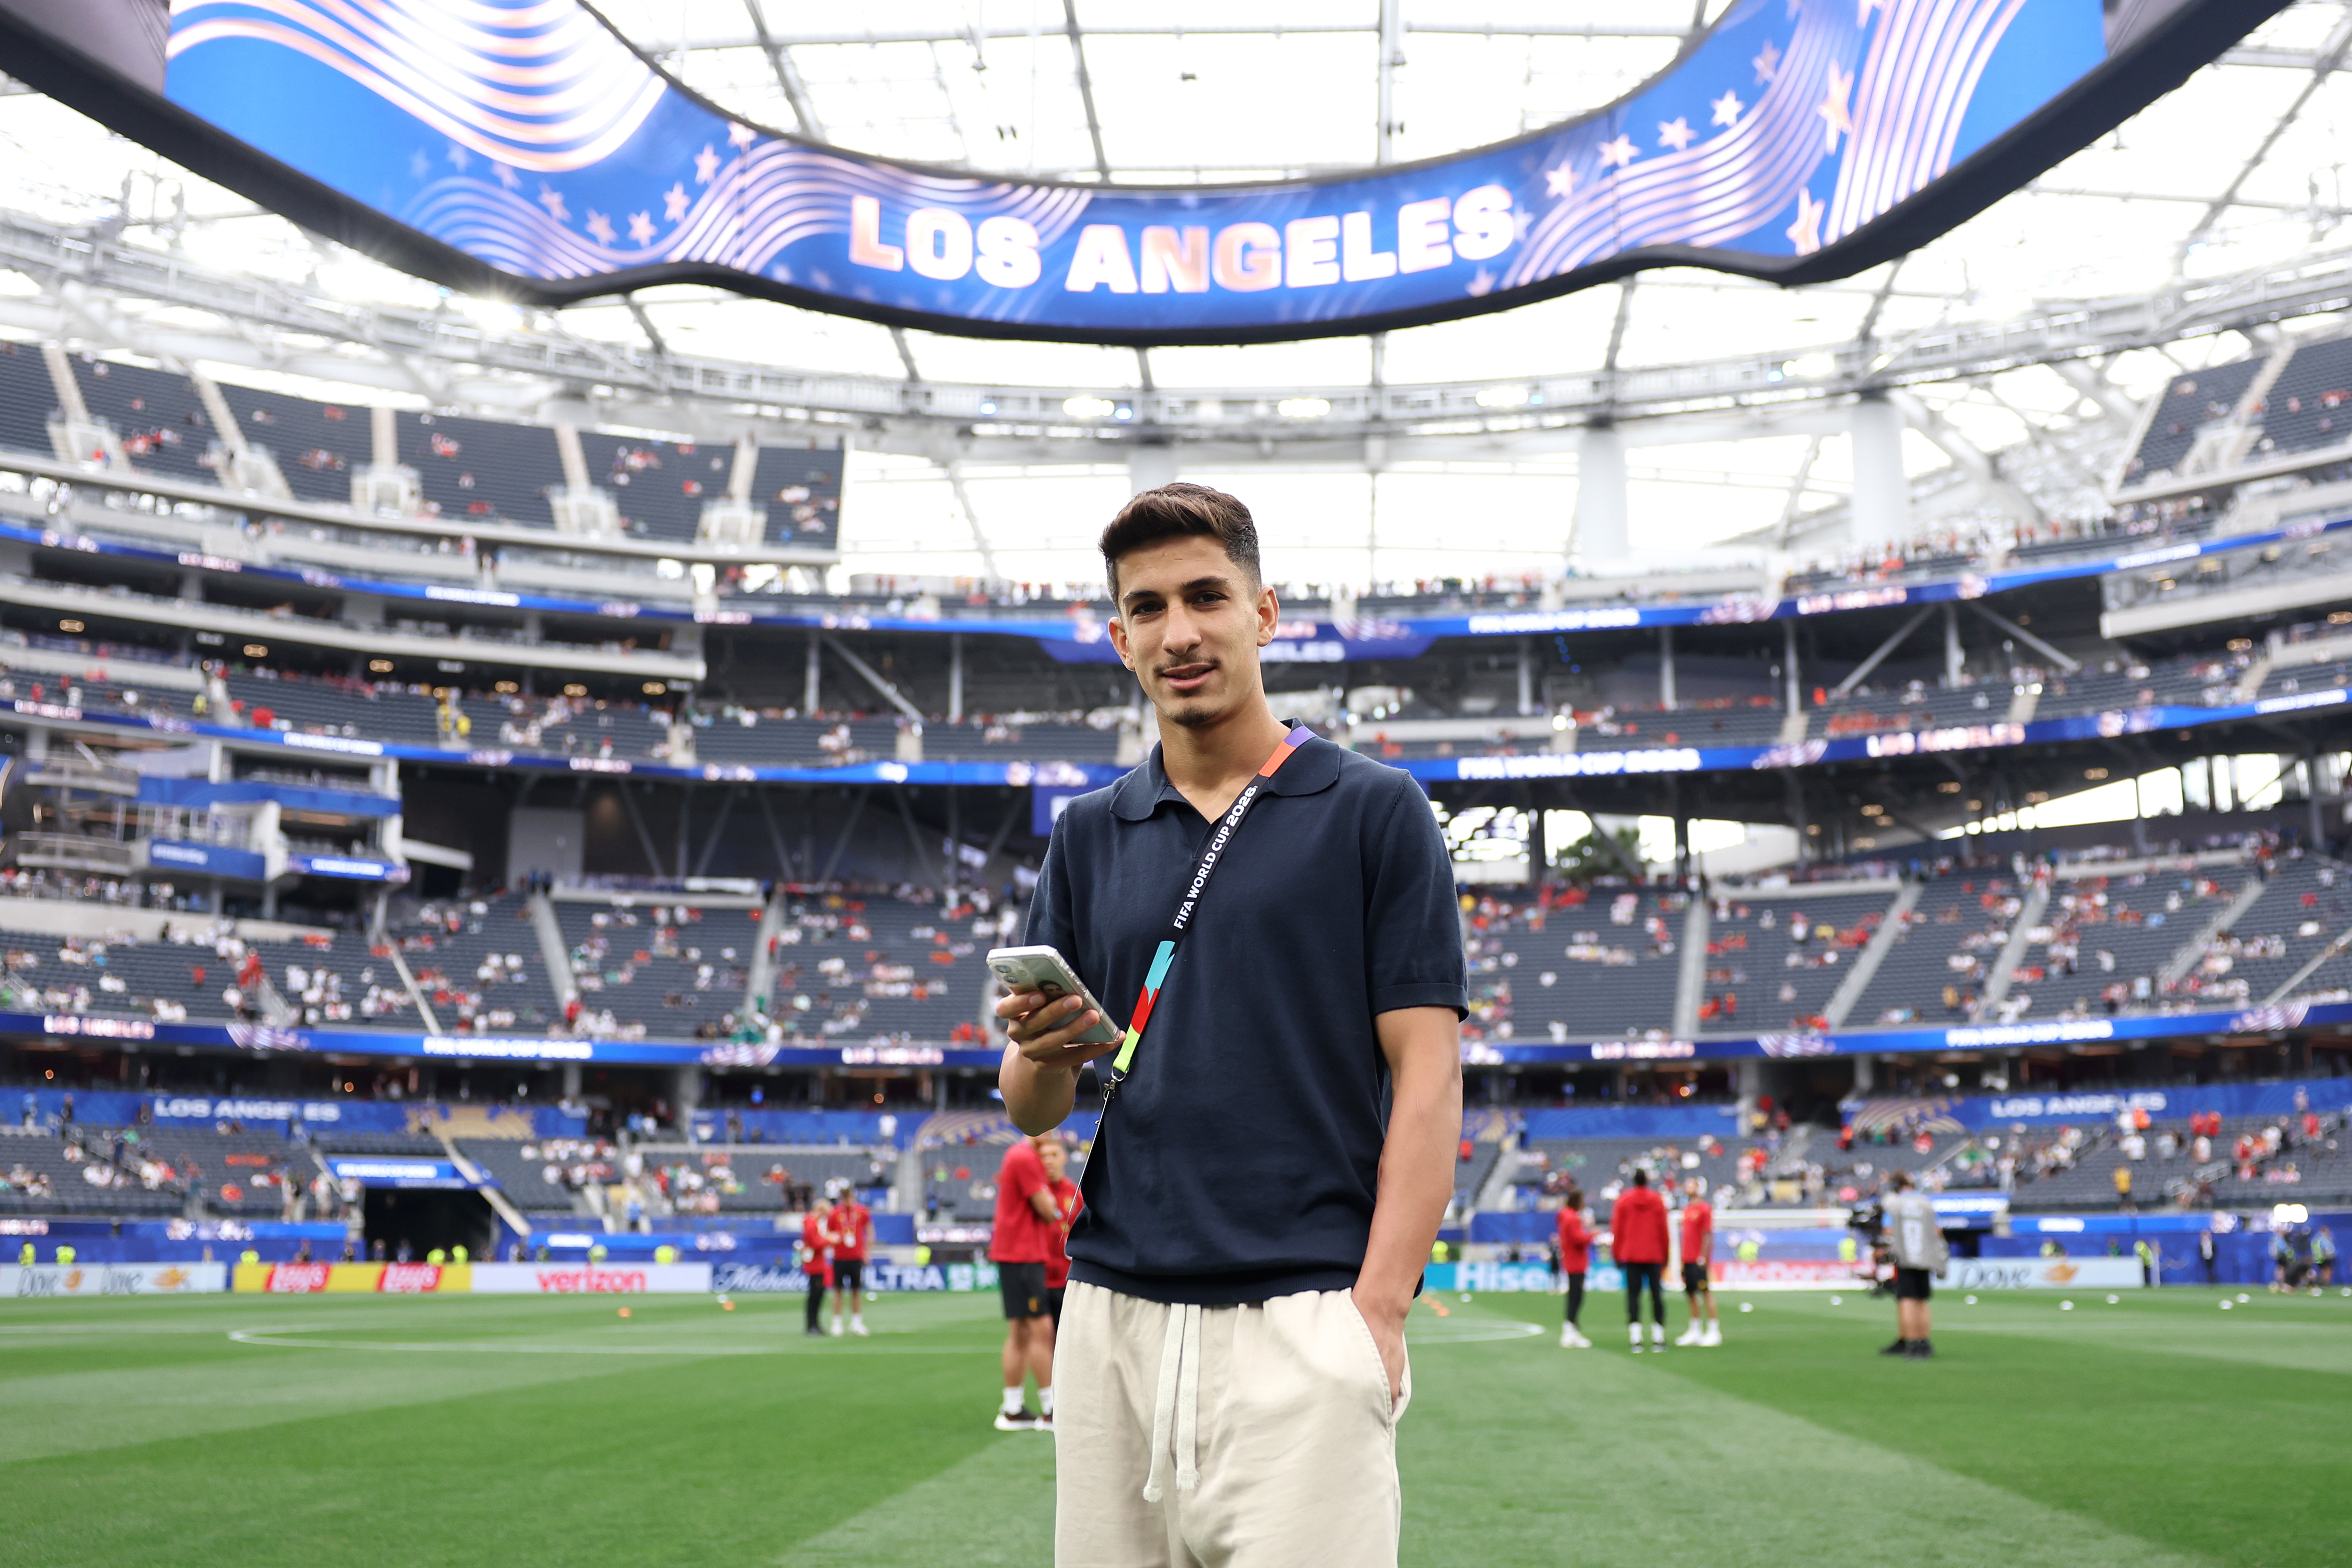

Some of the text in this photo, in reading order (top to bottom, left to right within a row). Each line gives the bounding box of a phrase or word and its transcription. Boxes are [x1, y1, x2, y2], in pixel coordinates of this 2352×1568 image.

[850, 184, 1516, 294] LOS ANGELES
[1173, 785, 1258, 929] FIFA WORLD CUP 2026
[154, 1098, 341, 1122] LOS ANGEES
[1991, 1098, 2044, 1118] LOS
[535, 1262, 646, 1293] verizon
[860, 1264, 946, 1291] LTRA
[1455, 1261, 1623, 1292] Hisee
[1957, 1259, 2031, 1290] Dove
